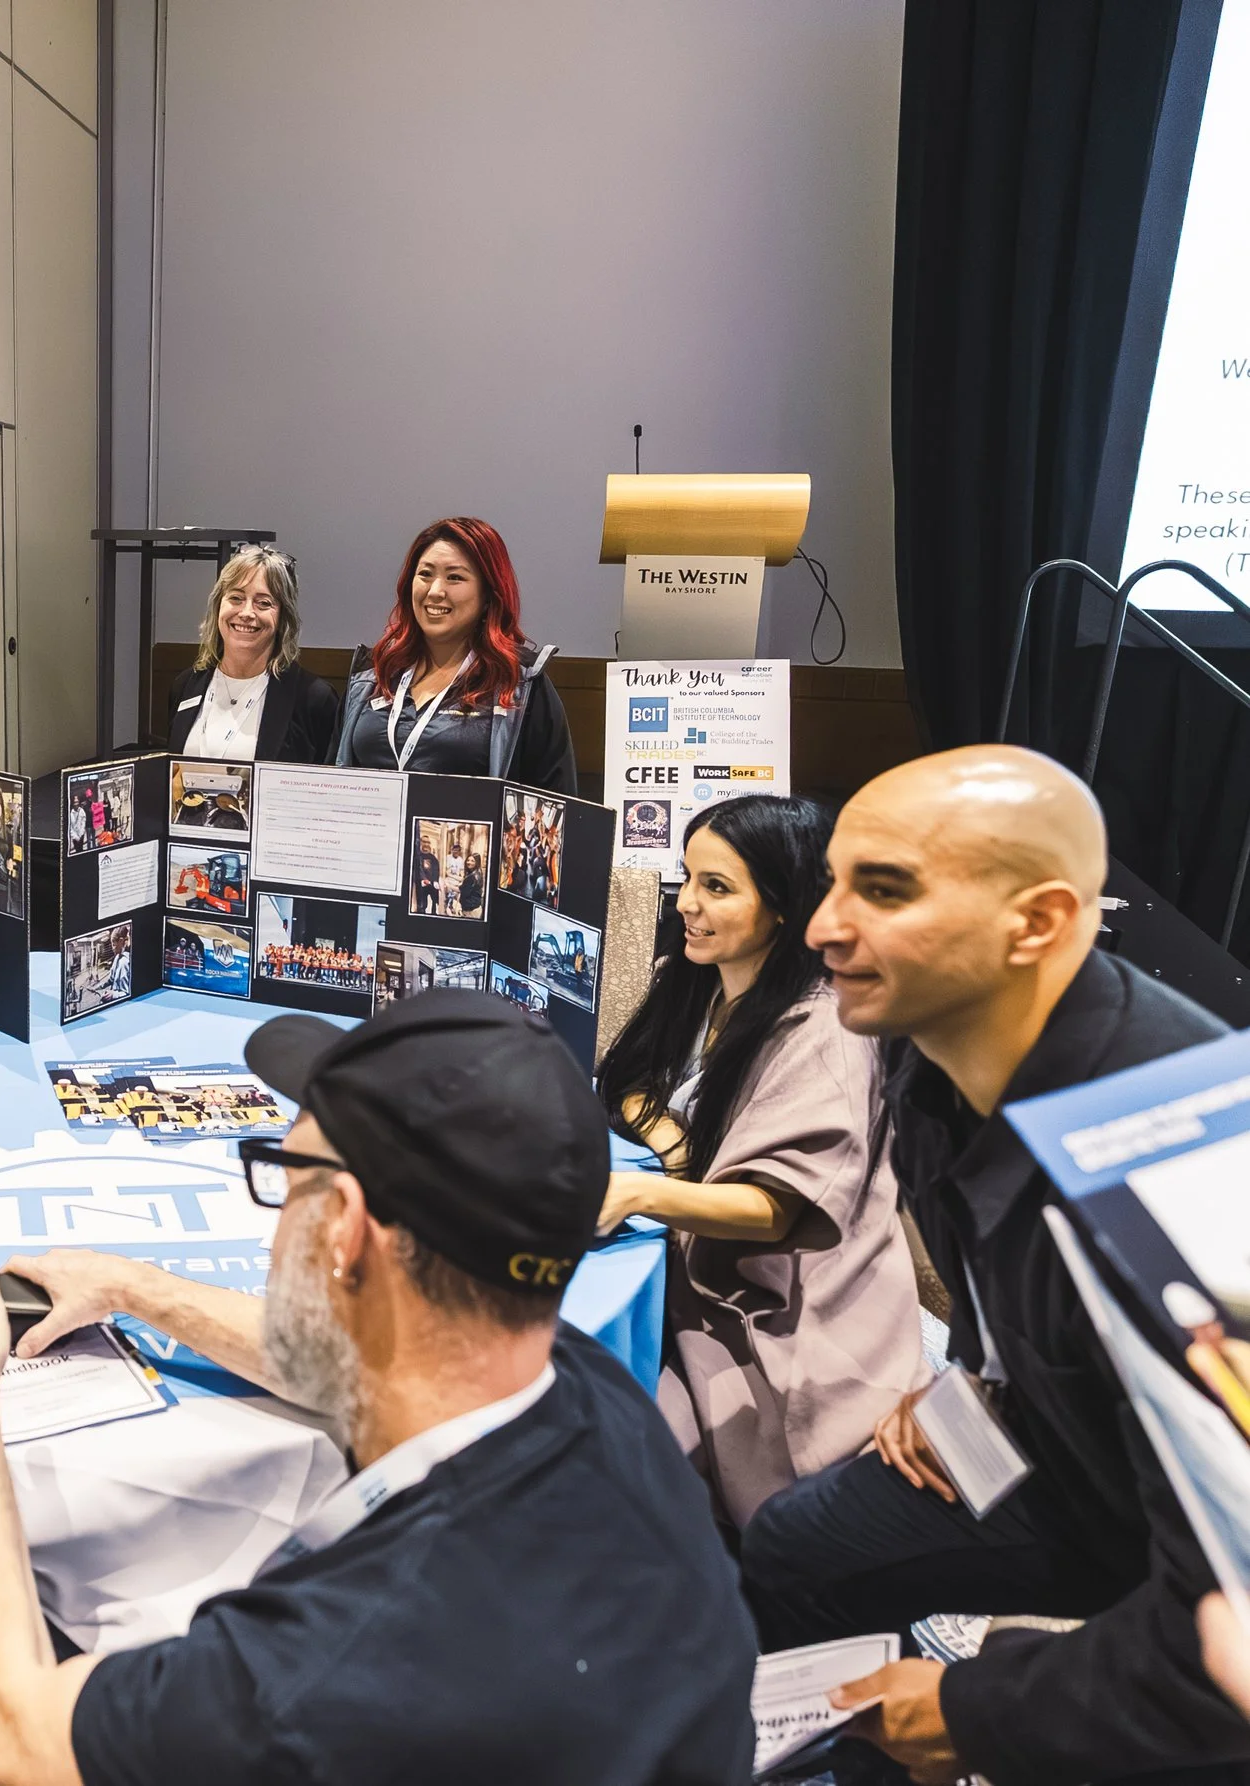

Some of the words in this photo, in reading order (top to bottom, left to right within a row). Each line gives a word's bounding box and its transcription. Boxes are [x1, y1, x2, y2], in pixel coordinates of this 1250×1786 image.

[1163, 518, 1250, 543] speaki
[621, 668, 682, 687] Thank
[687, 670, 725, 689] You
[730, 689, 765, 697] Sponsors
[632, 707, 666, 722] BCIT
[710, 730, 736, 738] College
[737, 730, 744, 738] of
[746, 730, 757, 738] the
[625, 740, 679, 750] SKILLED
[625, 767, 678, 784] CFEE
